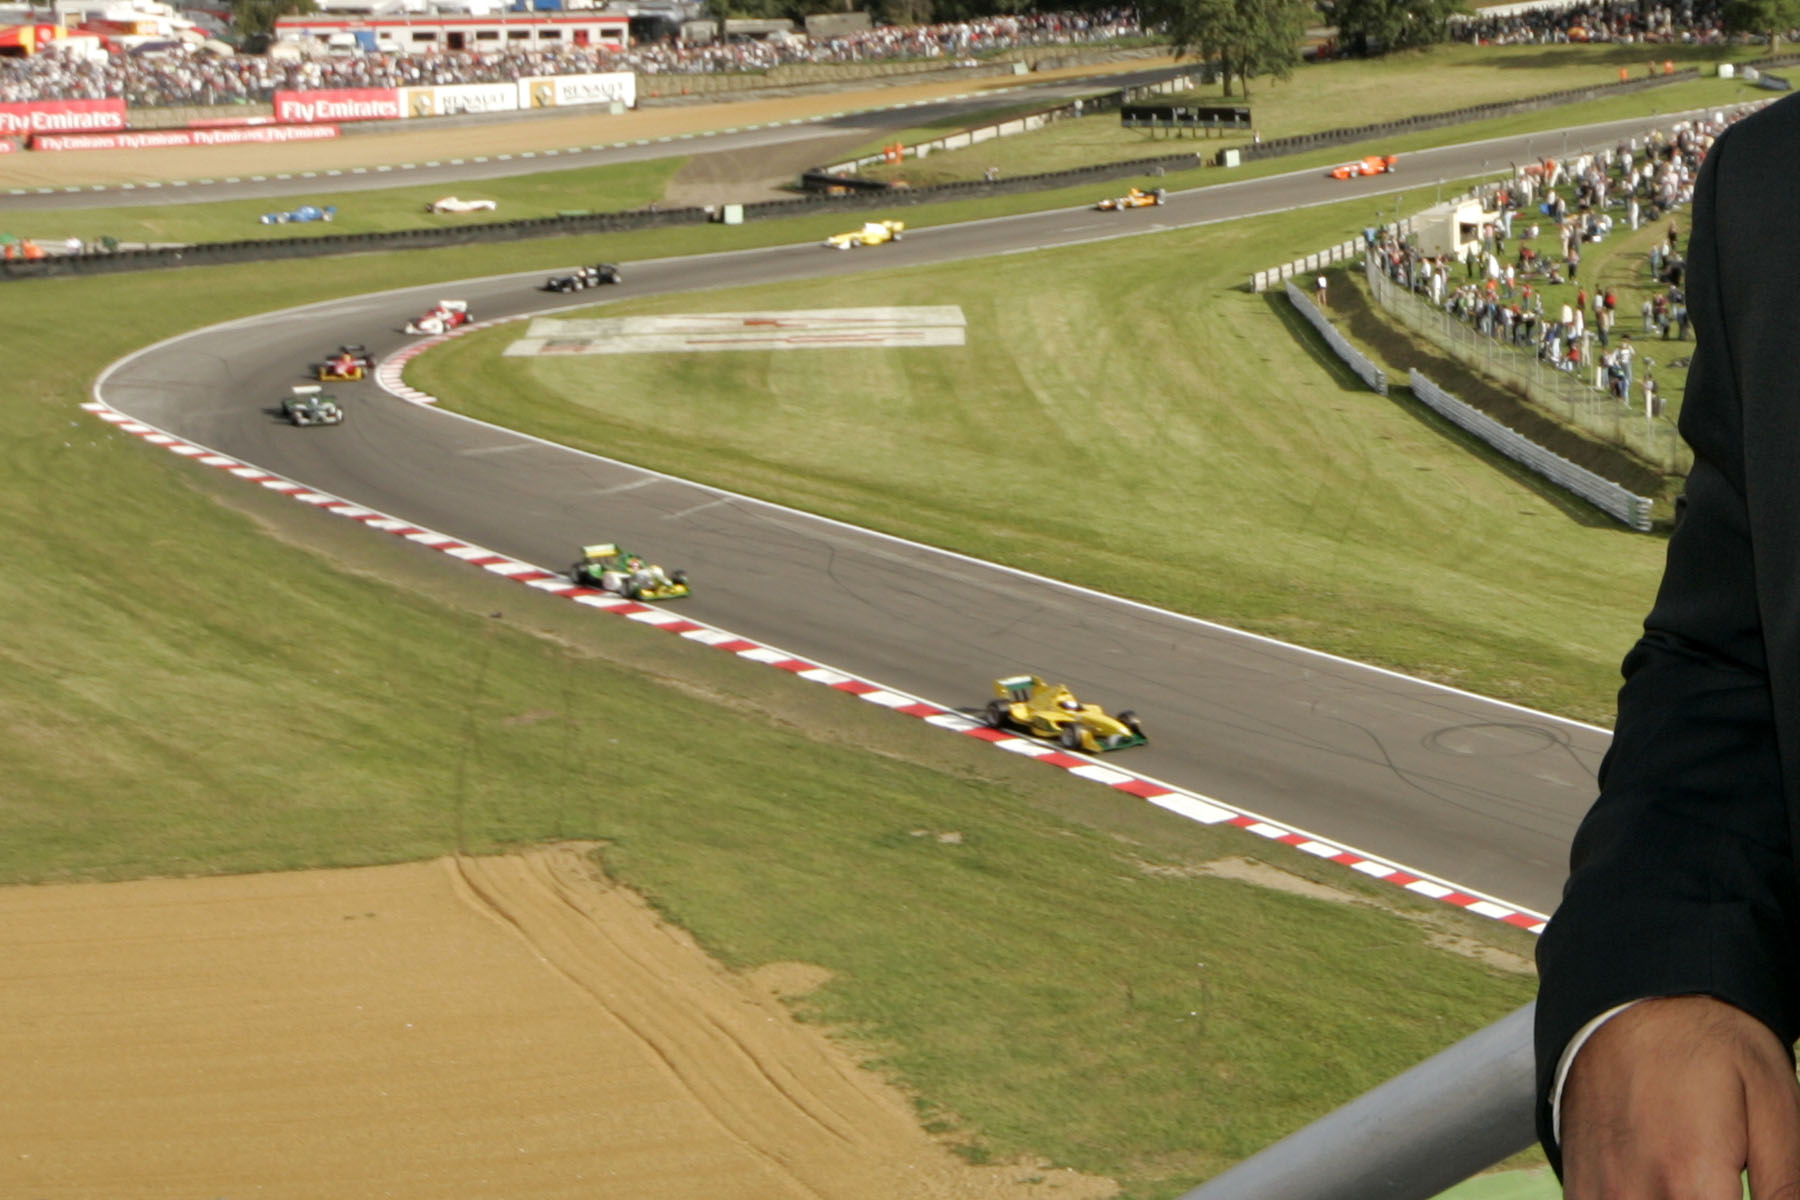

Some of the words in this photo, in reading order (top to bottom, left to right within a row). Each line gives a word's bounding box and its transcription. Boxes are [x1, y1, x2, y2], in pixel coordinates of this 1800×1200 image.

[0, 111, 30, 131] Fly
[32, 110, 122, 130] Emirates
[281, 100, 315, 123] Fly
[315, 99, 398, 119] Emirates
